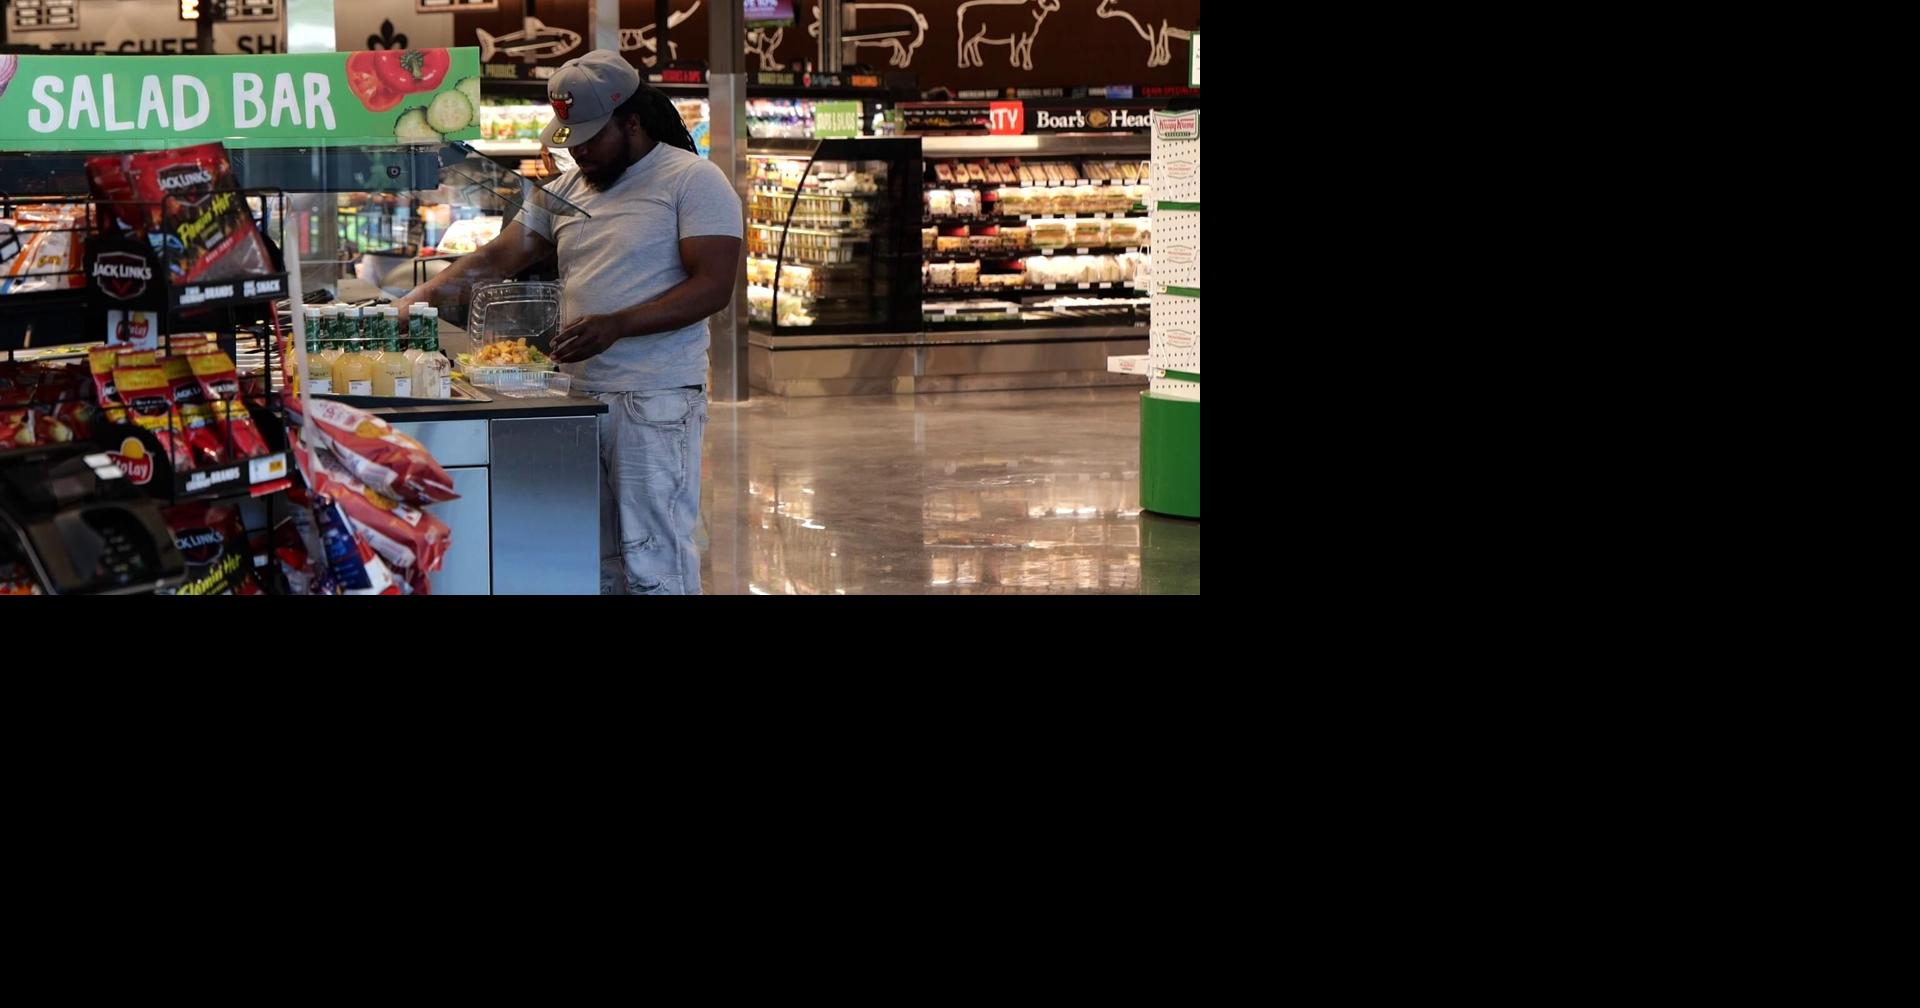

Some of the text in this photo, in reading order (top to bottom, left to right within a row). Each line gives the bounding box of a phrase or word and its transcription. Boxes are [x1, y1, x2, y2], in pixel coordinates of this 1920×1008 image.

[27, 72, 337, 133] SALAD BAR
[1037, 108, 1152, 129] Boar's Head
[92, 261, 119, 279] JACK
[175, 537, 192, 550] CK
